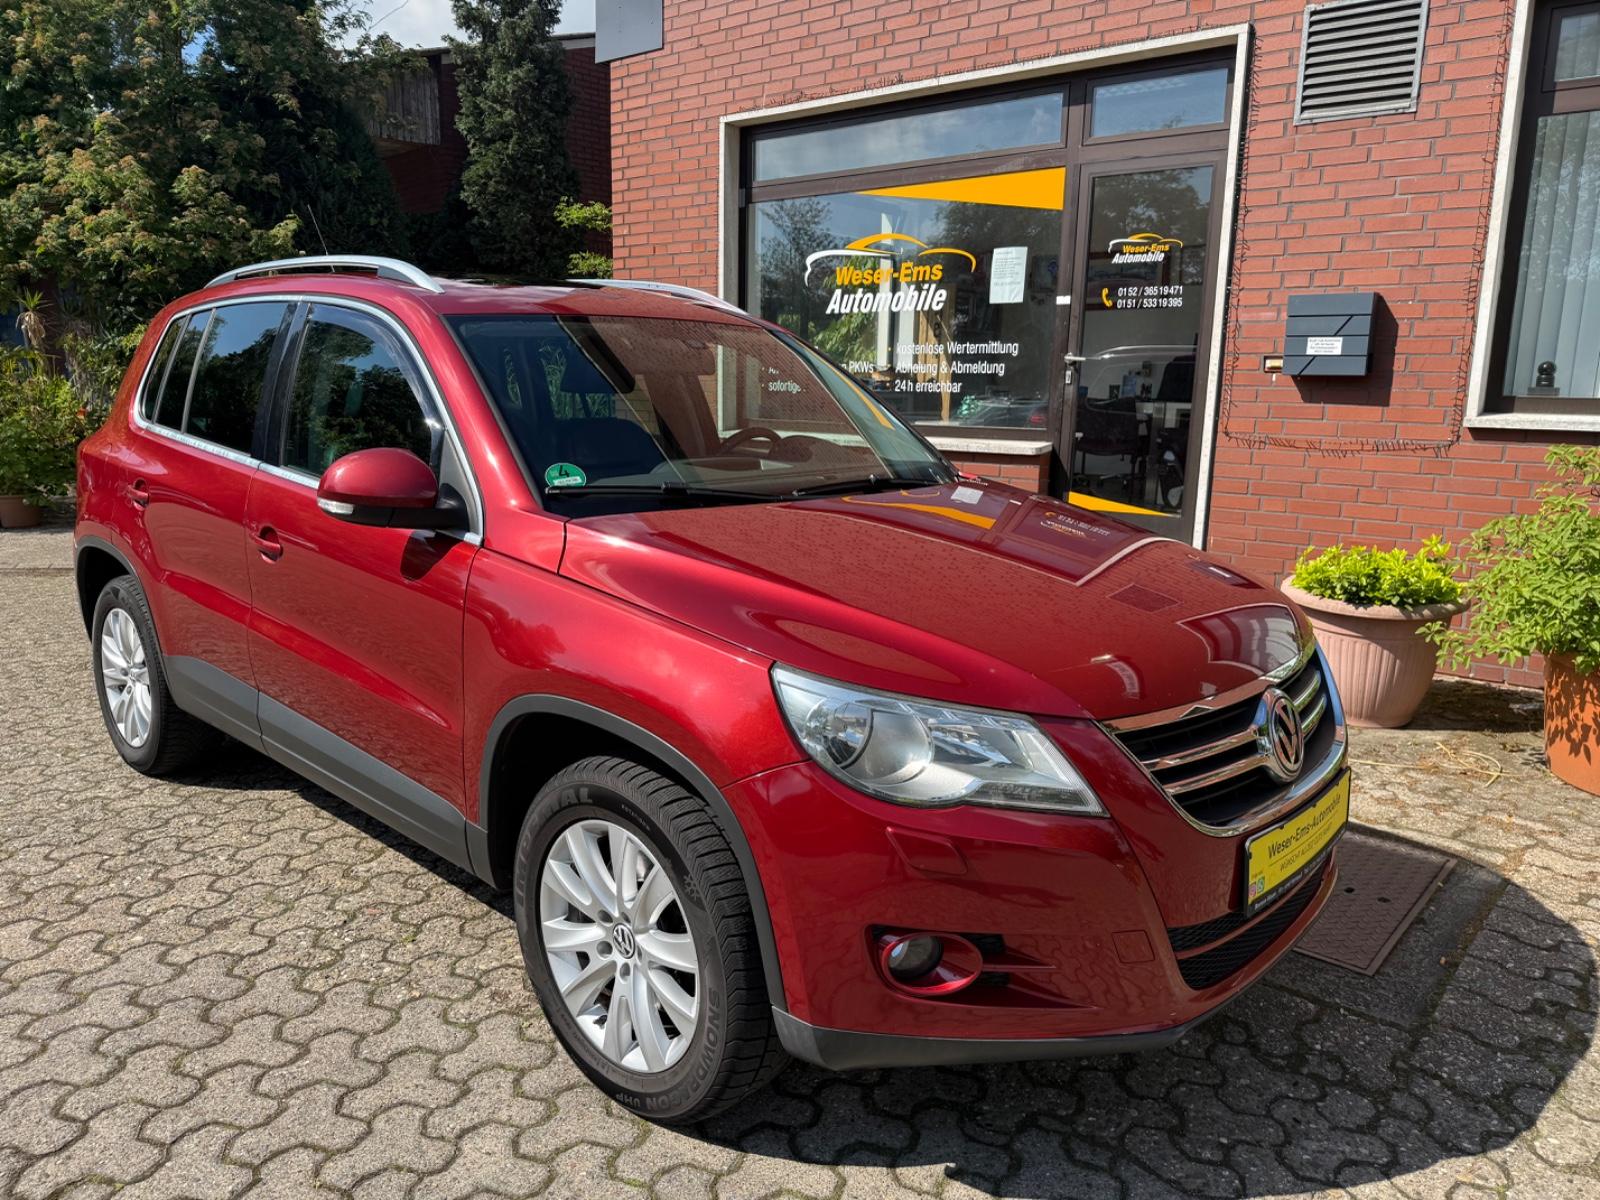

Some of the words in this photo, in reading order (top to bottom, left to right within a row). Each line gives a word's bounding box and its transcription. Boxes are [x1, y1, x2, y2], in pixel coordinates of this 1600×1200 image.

[1122, 244, 1170, 254] Weser-Ems
[1112, 252, 1165, 264] Automobile
[835, 262, 944, 286] Weser-Ems
[825, 283, 948, 315] Automobile
[1117, 287, 1138, 297] 0152
[1116, 298, 1137, 309] 0151
[896, 342, 945, 355] kostenlose
[946, 340, 1020, 356] Wertermittlung
[848, 360, 874, 374] PKWs
[894, 361, 938, 377] Abholung
[940, 361, 949, 374] &
[949, 360, 1006, 377] Abmeldung
[915, 380, 963, 393] erreichbar
[558, 464, 571, 478] 4
